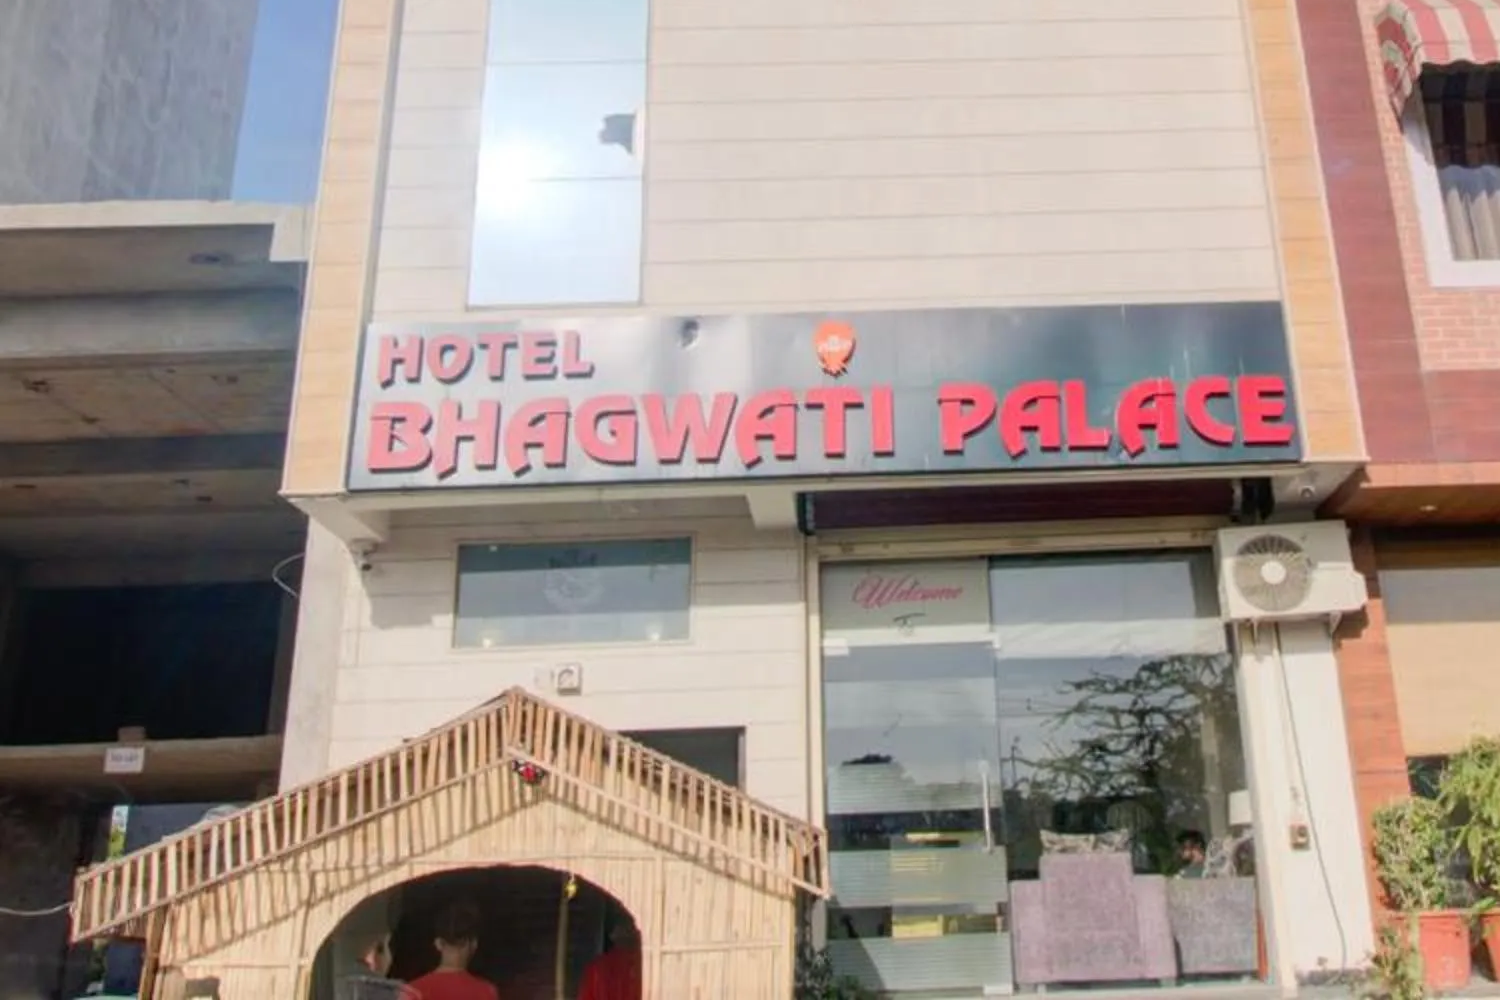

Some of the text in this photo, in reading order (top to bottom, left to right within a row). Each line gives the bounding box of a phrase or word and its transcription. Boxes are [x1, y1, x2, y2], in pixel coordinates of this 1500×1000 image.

[377, 331, 595, 388] HOTEL
[367, 375, 1295, 479] BHAGWATI PALACE
